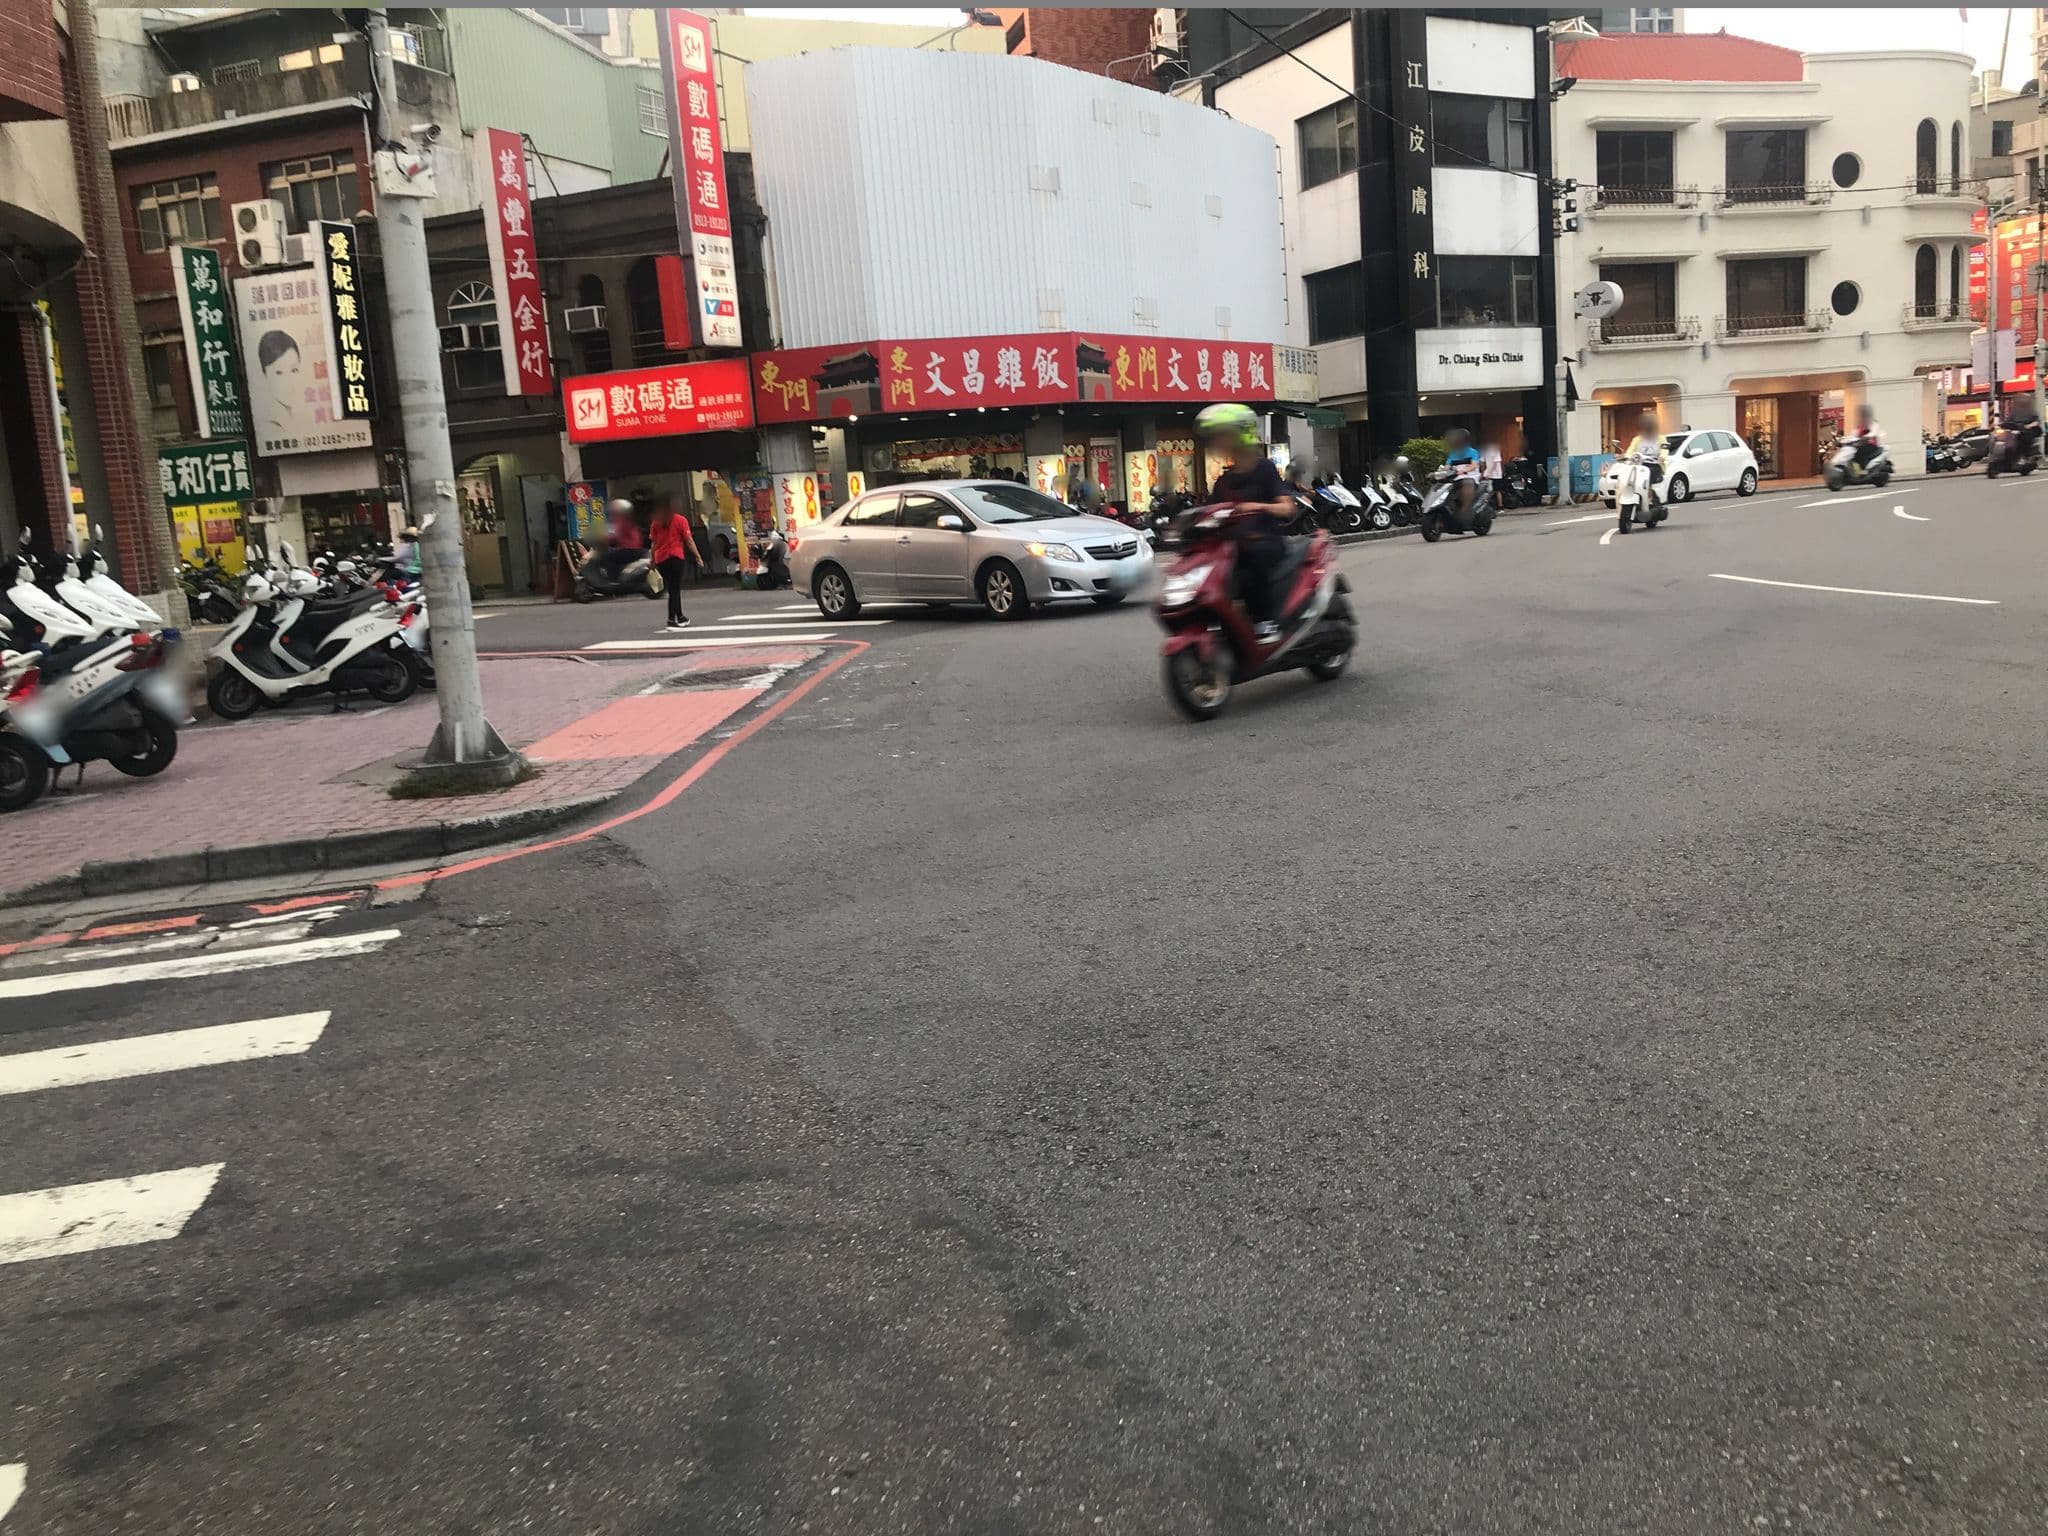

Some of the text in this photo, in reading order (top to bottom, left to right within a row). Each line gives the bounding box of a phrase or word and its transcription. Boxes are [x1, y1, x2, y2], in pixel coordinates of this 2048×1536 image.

[686, 79, 720, 209] 數碼通
[1406, 60, 1430, 279] 江皮膚科
[498, 147, 544, 378] 萬豐五金行
[190, 255, 231, 377] 萬和行
[327, 231, 370, 413] 愛妮雅化妝品
[760, 360, 811, 412] 東門
[890, 346, 916, 406] 東門
[923, 346, 1070, 396] 文昌雞飯
[1439, 352, 1524, 367] Dr. Chiang Skin Clinic
[609, 378, 696, 417] 數碼通
[615, 413, 668, 428] SUMA TONE
